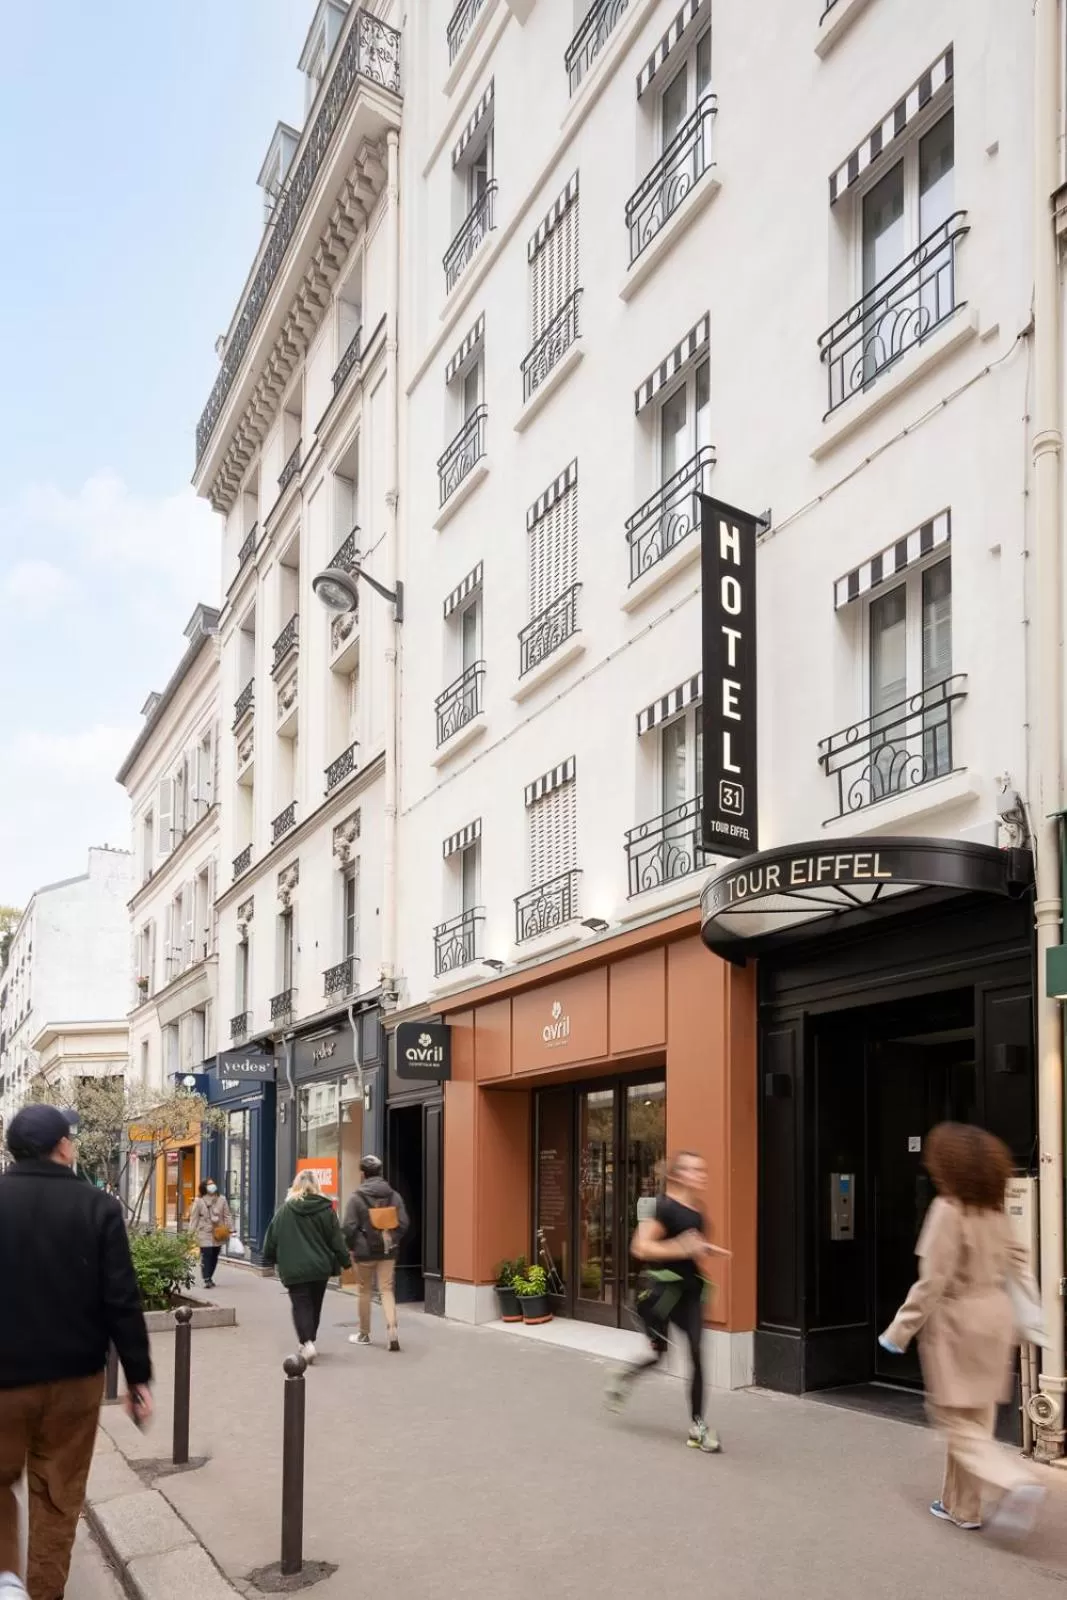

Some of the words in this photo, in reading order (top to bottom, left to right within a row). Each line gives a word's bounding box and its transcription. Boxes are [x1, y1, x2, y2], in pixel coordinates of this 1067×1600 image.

[719, 520, 742, 773] HOTEL
[723, 787, 740, 808] 31
[710, 820, 730, 834] TOUR
[730, 824, 750, 841] EIFFEL
[727, 864, 781, 902] TOUR
[790, 853, 892, 885] EIFFEL
[543, 1015, 570, 1042] avril
[405, 1046, 443, 1062] avril
